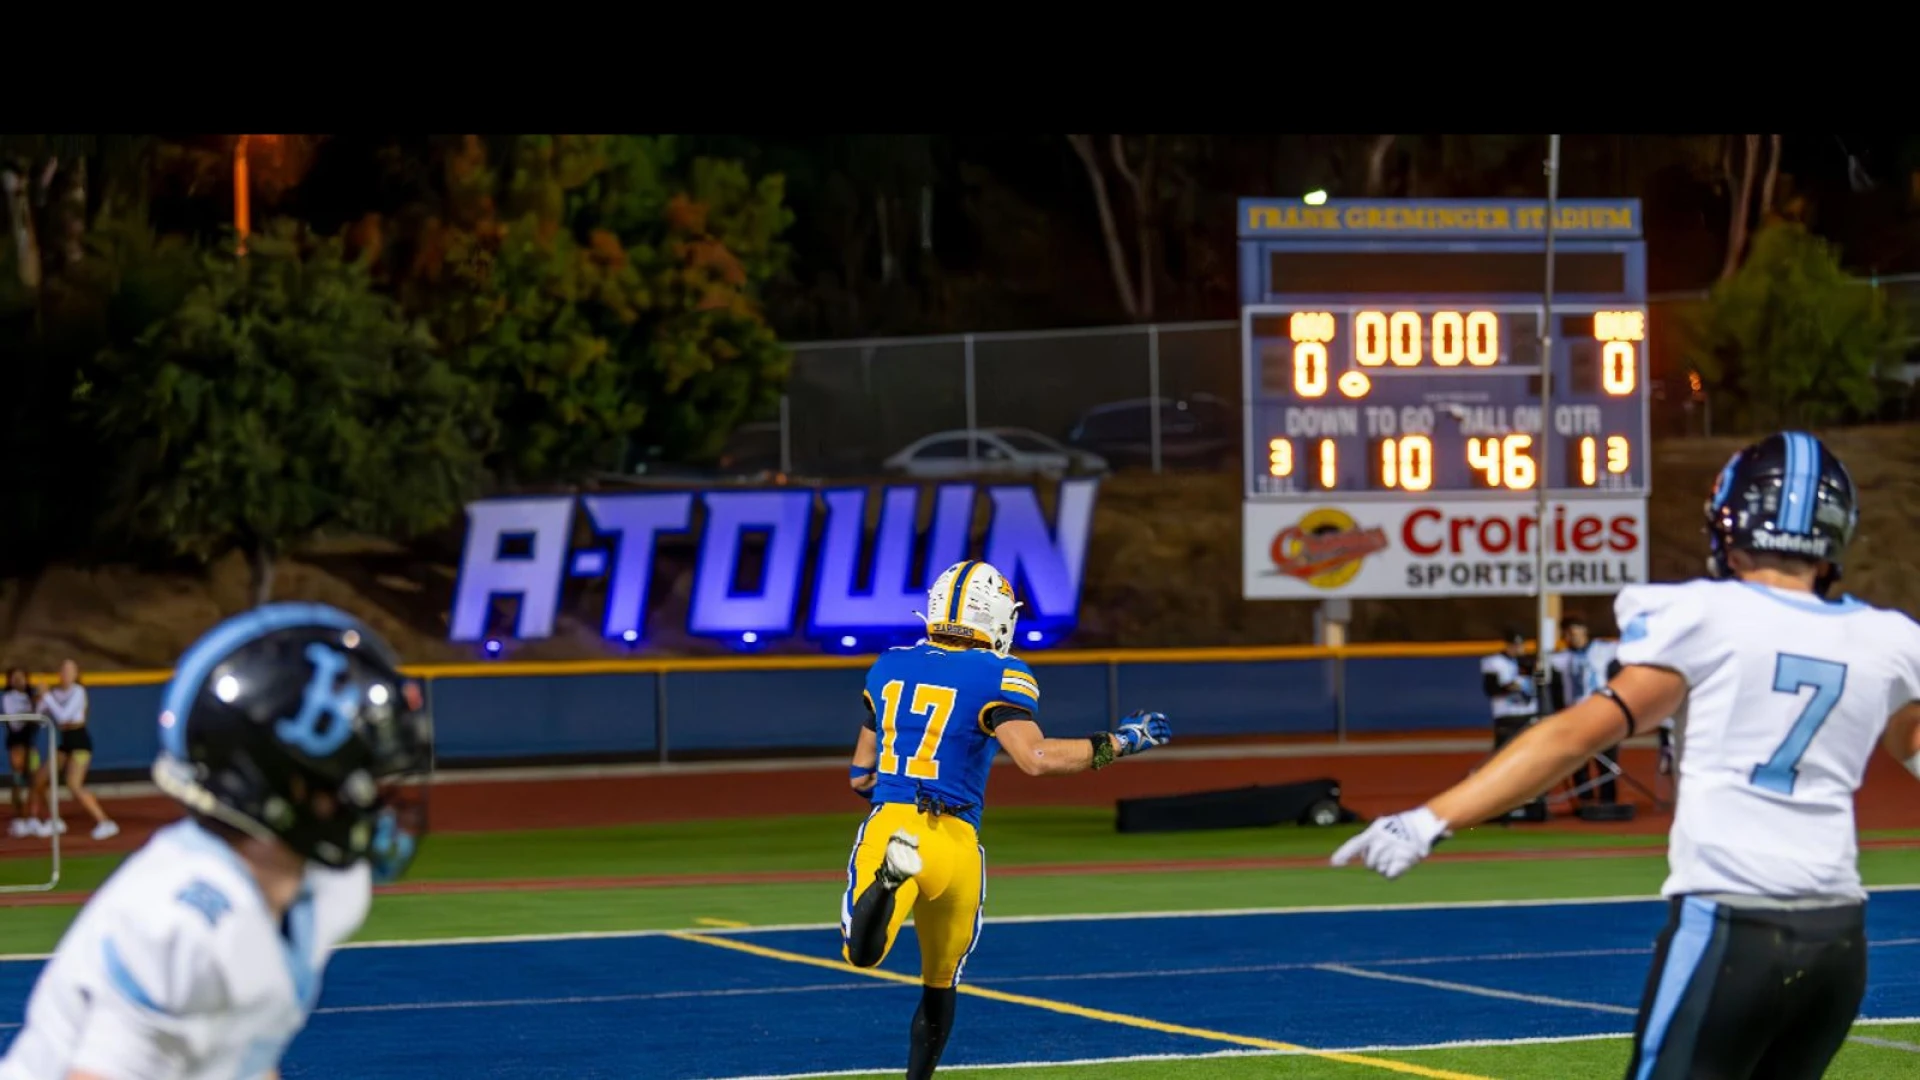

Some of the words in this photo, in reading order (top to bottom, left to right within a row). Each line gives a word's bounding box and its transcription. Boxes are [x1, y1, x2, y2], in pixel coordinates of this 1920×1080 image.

[1248, 207, 1341, 230] FRANK
[1344, 207, 1511, 230] GREMINGER
[1294, 341, 1328, 397] 0
[1602, 341, 1636, 395] 0
[1285, 407, 1358, 437] DOWN
[1365, 407, 1397, 436] TO
[1400, 407, 1435, 436] GO
[1555, 405, 1602, 432] QTR
[1268, 438, 1294, 476] 3
[1320, 438, 1336, 489] 1
[1381, 434, 1433, 491] 10
[1466, 434, 1537, 490] 46
[1581, 436, 1596, 486] 1
[1607, 437, 1630, 474] 3
[449, 479, 1098, 642] A-TOWN
[1405, 562, 1533, 588] SPORTS
[1544, 560, 1637, 585] GRILL
[877, 679, 958, 781] 17
[1749, 651, 1848, 795] 7
